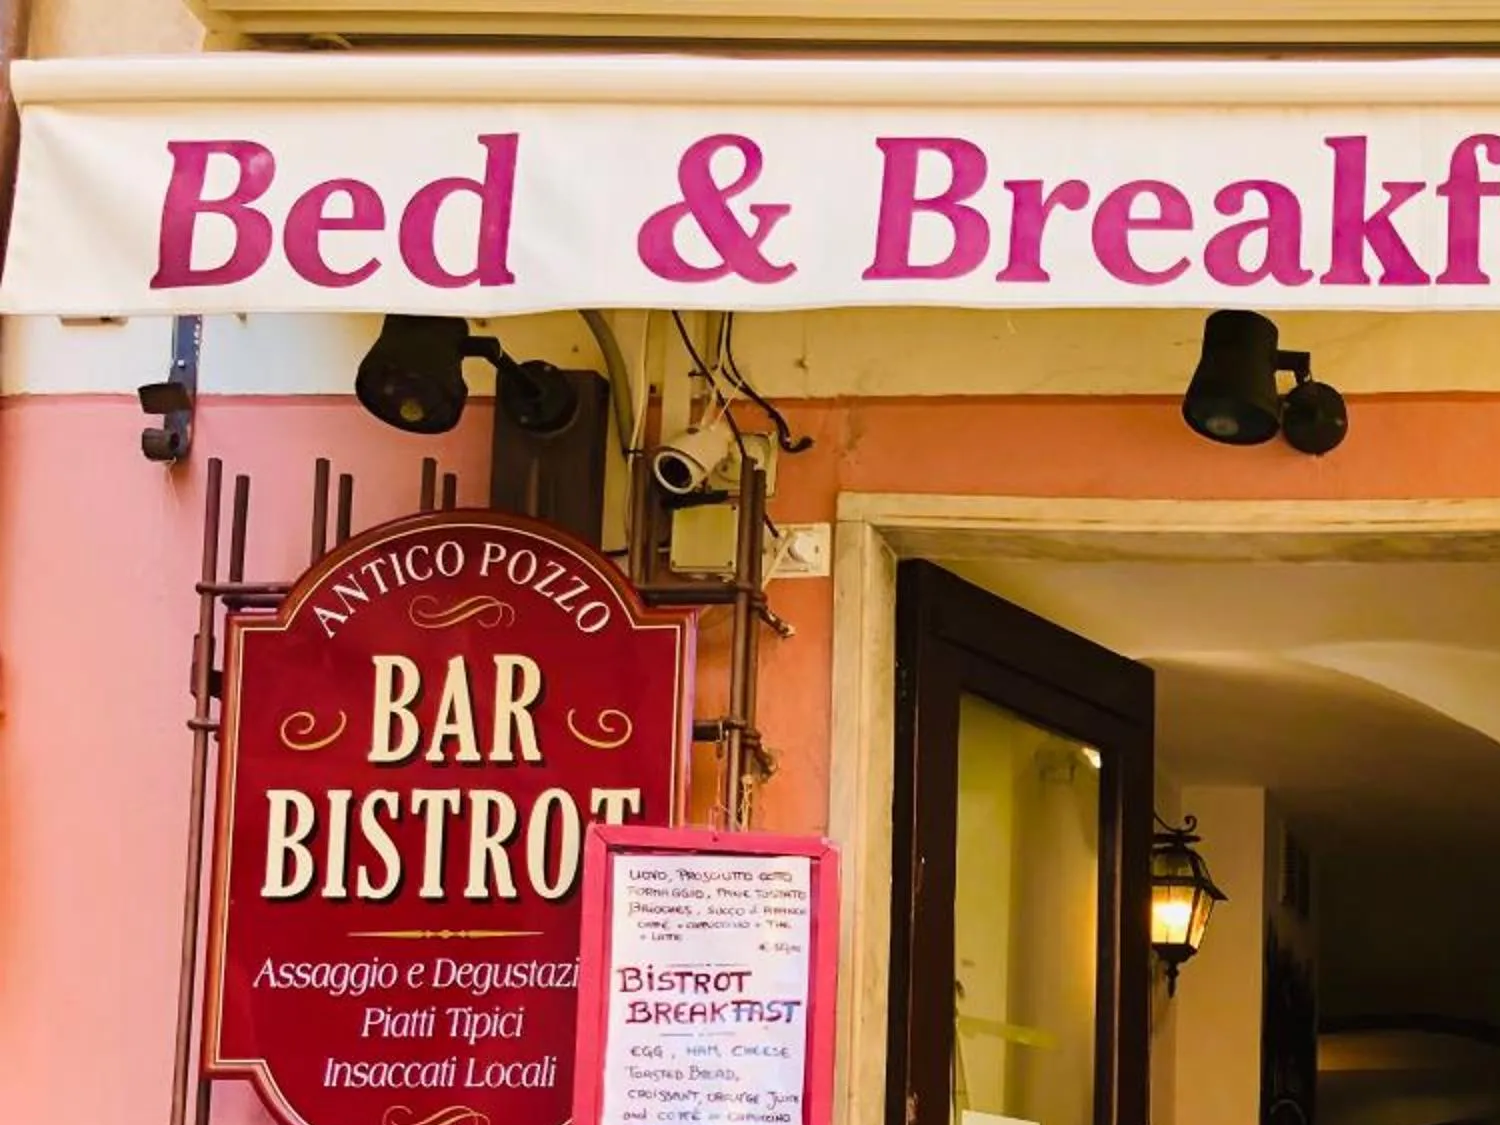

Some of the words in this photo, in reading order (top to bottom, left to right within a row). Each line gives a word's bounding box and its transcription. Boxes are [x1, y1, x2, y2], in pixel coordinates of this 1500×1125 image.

[150, 132, 519, 290] Bed
[637, 132, 797, 285] &
[311, 541, 465, 638] ANTICO
[479, 543, 612, 633] POZZO
[368, 654, 543, 765] BAR
[253, 958, 397, 996] Assaggio
[407, 964, 423, 988] e
[433, 958, 578, 996] Degustazi
[616, 965, 753, 994] BISTROT
[361, 1007, 434, 1038] Piatti
[446, 1007, 523, 1045] Tipici
[625, 999, 801, 1025] BREAKFAST
[731, 1045, 792, 1059] CHEESE
[323, 1057, 455, 1088] Insaccati
[465, 1057, 556, 1088] Locali
[625, 1065, 684, 1082] TOASTED
